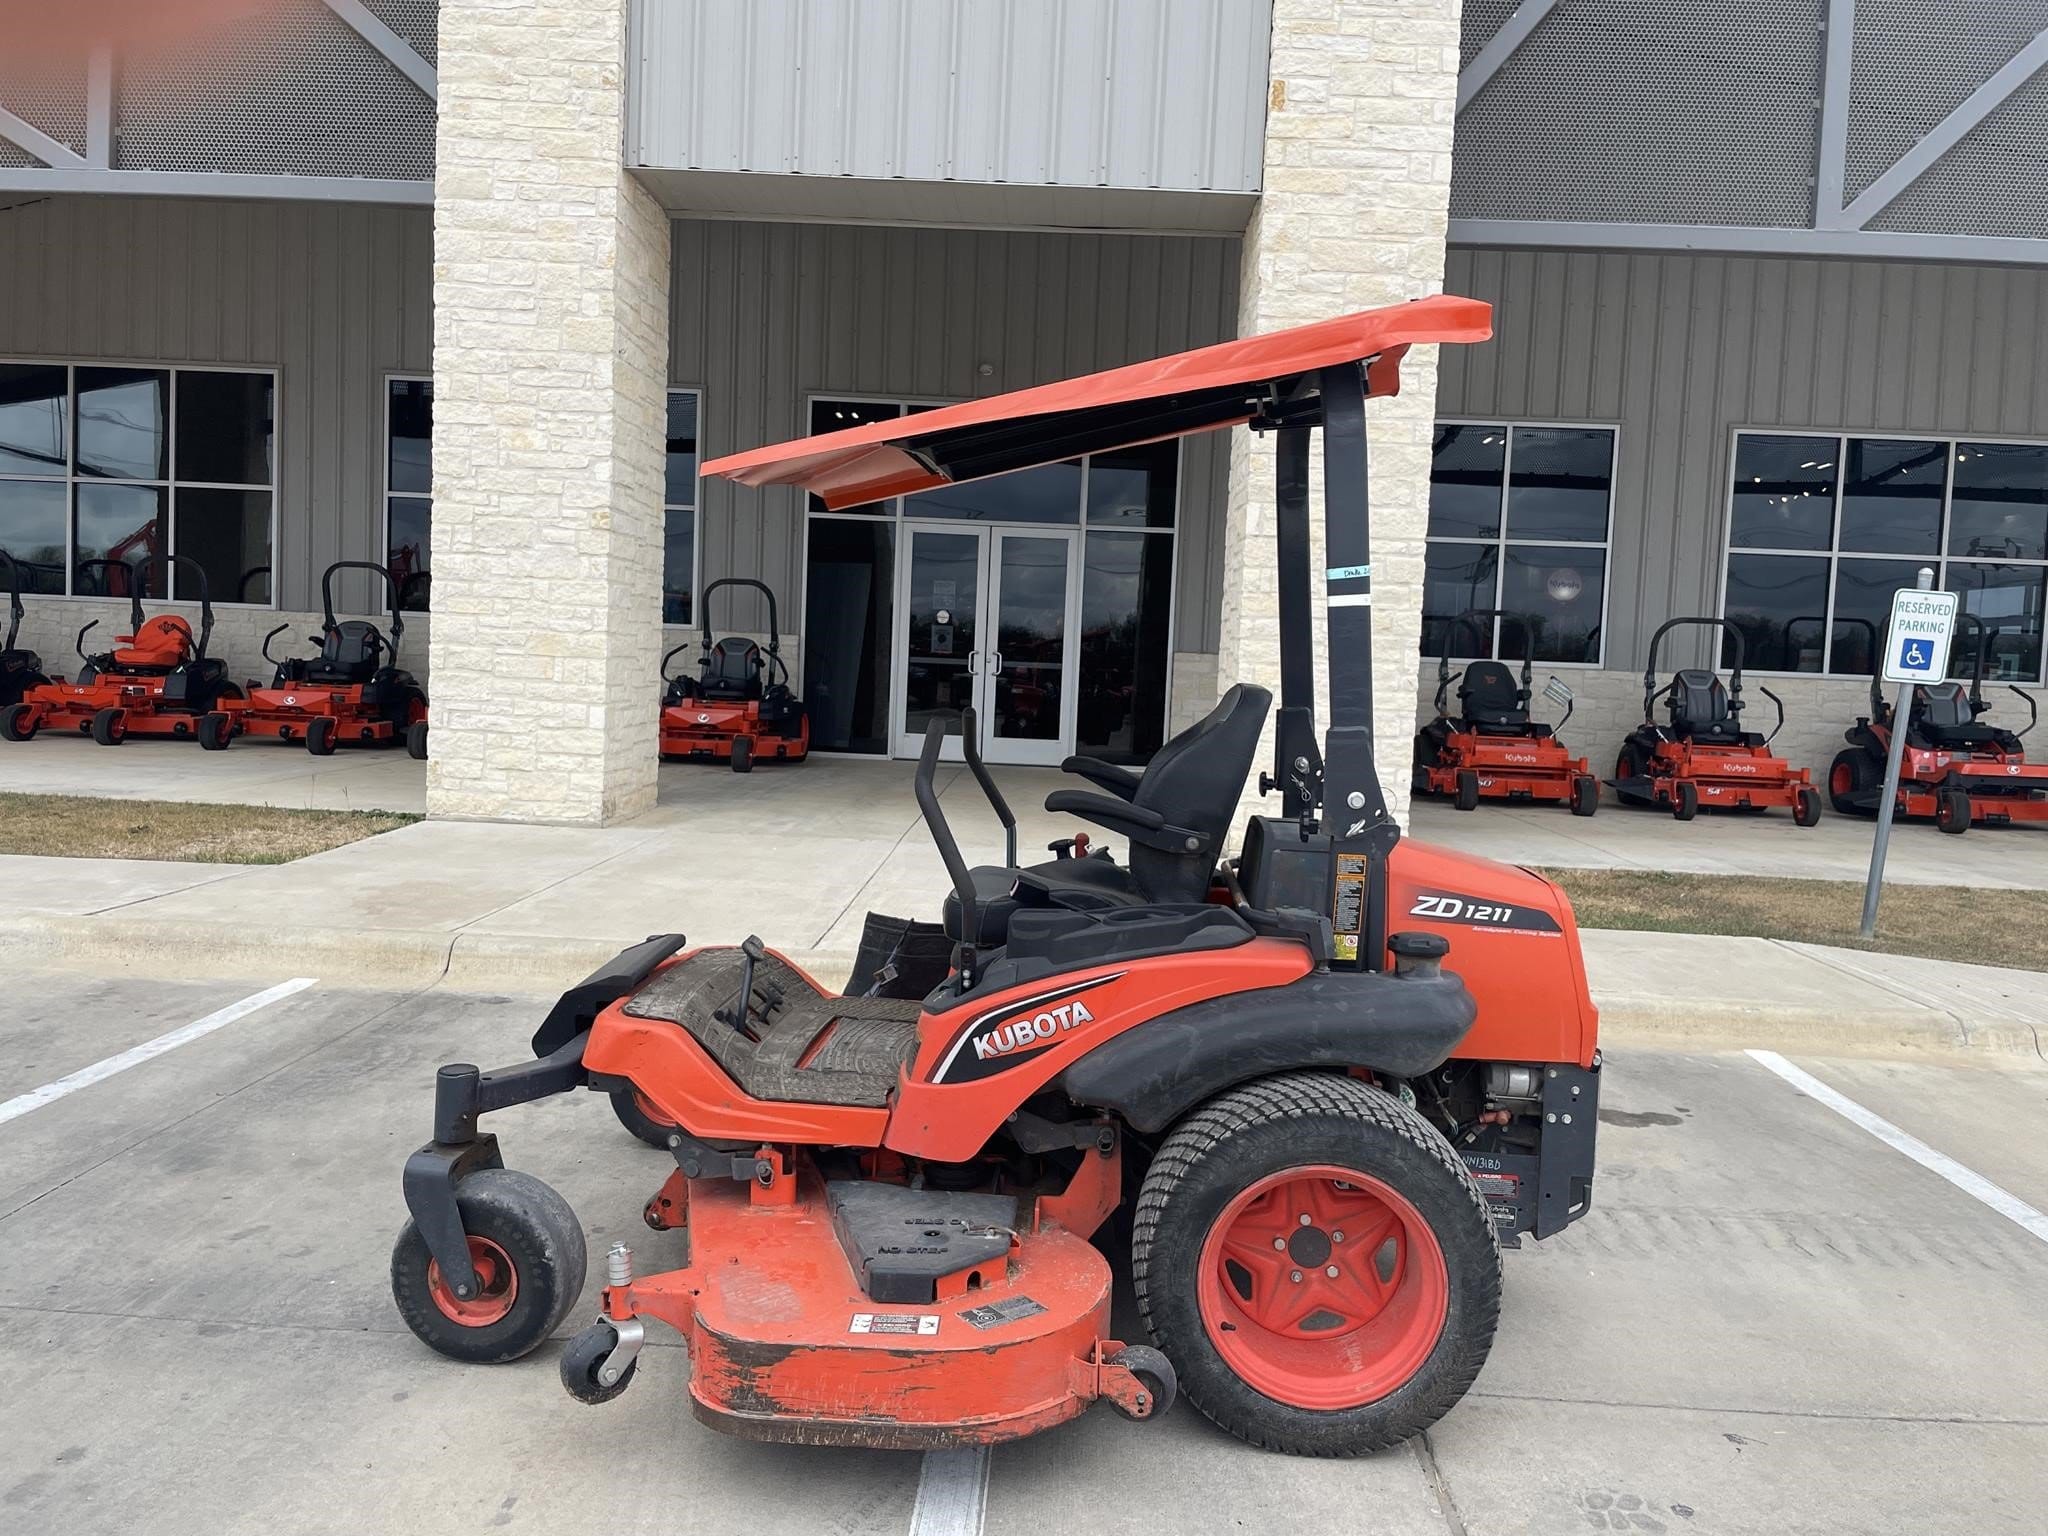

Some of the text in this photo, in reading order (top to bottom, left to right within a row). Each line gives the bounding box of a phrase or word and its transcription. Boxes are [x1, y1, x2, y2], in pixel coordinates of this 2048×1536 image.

[1898, 601, 1951, 616] RESERVED
[1898, 620, 1945, 633] PARKING
[1505, 753, 1536, 763] Kubota
[1723, 763, 1756, 773] Kubota
[1409, 895, 1513, 922] ZD 1211
[972, 1000, 1095, 1060] KUBOTA
[878, 1246, 901, 1255] NO
